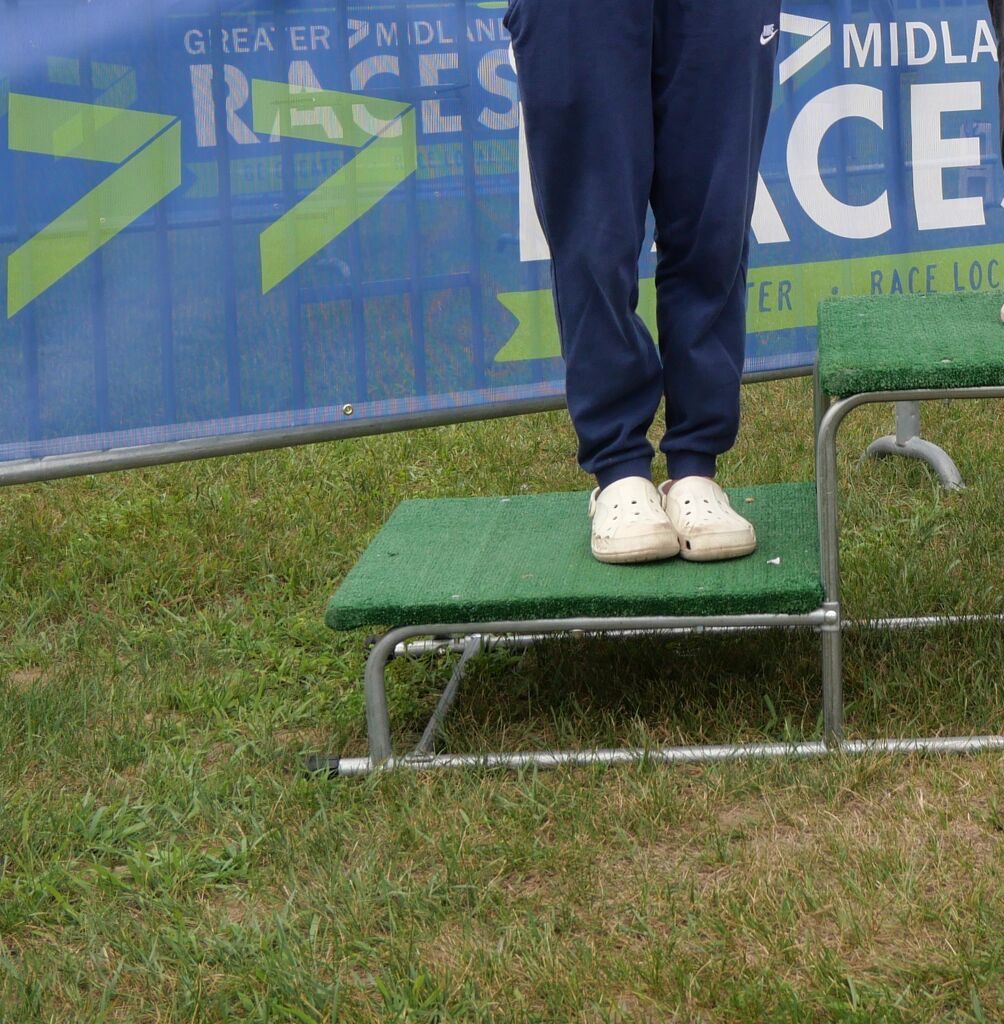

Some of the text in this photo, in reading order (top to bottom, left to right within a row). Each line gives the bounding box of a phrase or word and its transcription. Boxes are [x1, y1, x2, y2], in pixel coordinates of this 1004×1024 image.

[843, 19, 999, 68] MIDLA
[189, 48, 521, 148] RACES
[871, 264, 937, 295] RACE
